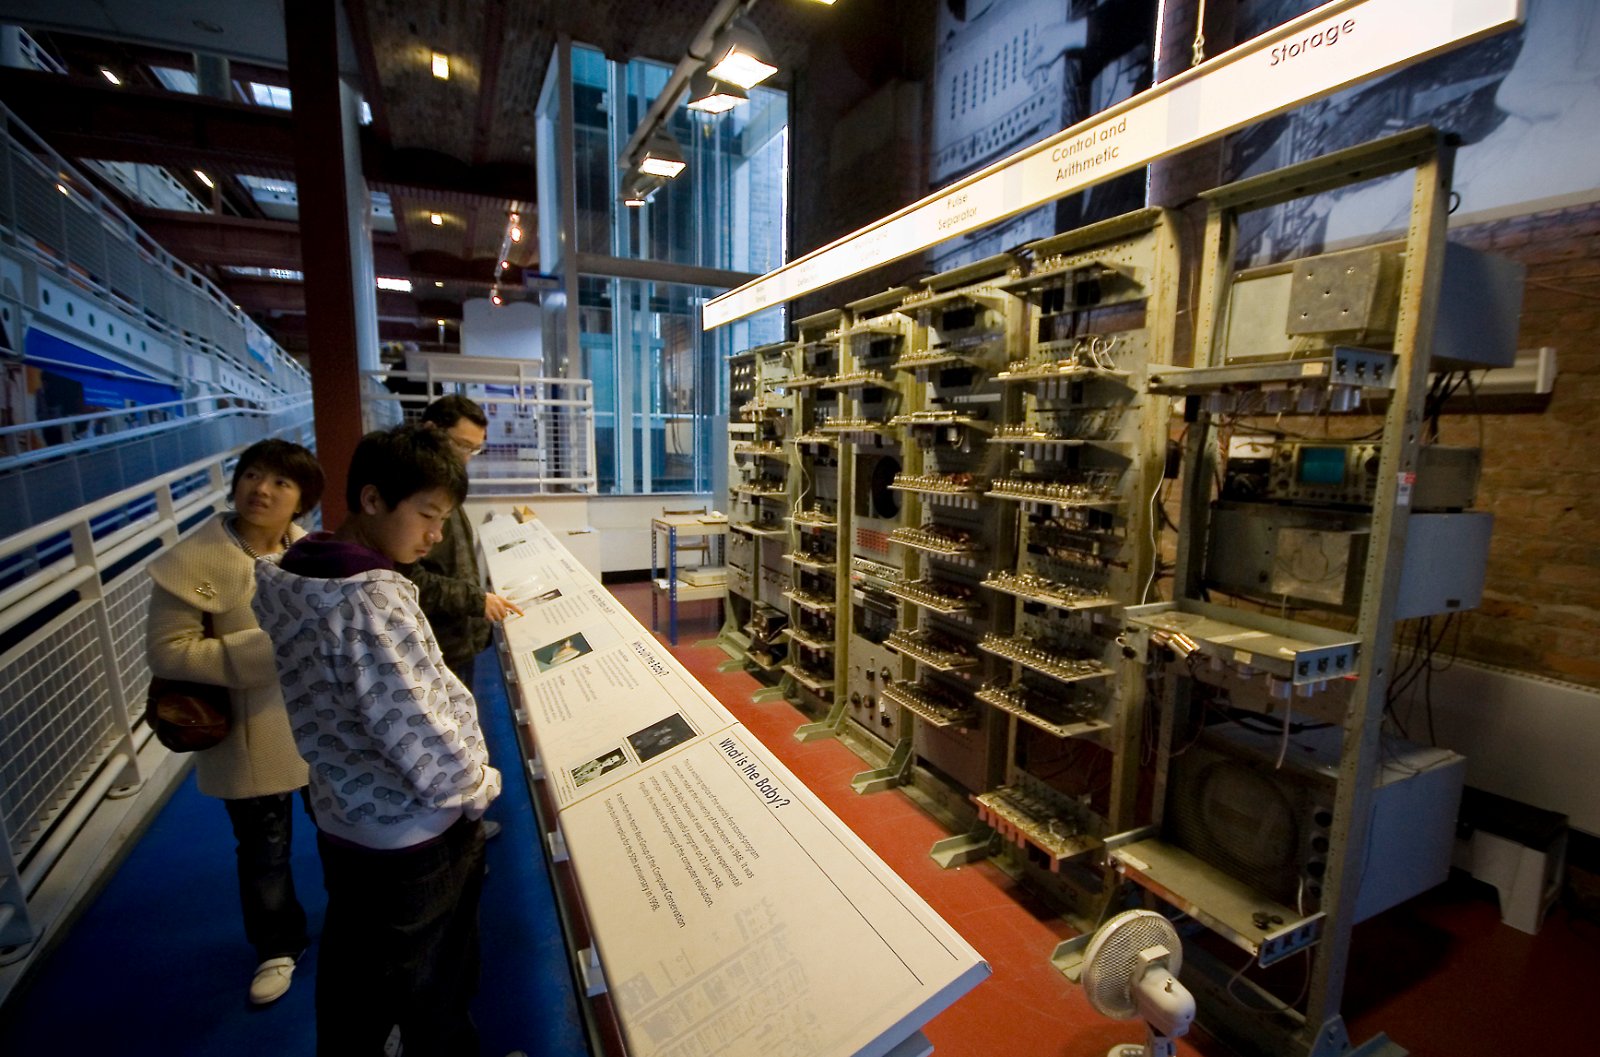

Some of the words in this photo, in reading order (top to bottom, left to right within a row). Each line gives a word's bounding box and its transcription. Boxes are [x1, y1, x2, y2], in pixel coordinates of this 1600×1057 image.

[1270, 19, 1355, 66] Storage
[1052, 132, 1096, 162] Control
[1100, 117, 1127, 141] and
[1056, 146, 1119, 182] Arithmetic
[938, 207, 977, 230] Separator
[717, 736, 744, 760] What
[734, 755, 751, 767] is
[741, 762, 764, 781] the
[690, 791, 700, 800] the
[710, 796, 721, 806] the
[755, 777, 790, 810] Baby?
[667, 804, 678, 815] first
[693, 797, 712, 818] University
[628, 818, 640, 832] North
[658, 815, 667, 824] the
[672, 812, 690, 834] successful
[724, 815, 737, 827] first
[621, 837, 631, 847] for
[634, 829, 645, 842] West
[660, 821, 679, 845] beginning
[681, 831, 699, 853] program
[710, 819, 732, 846] Manchester
[729, 823, 762, 861] stored-program
[624, 843, 634, 855] the
[637, 839, 651, 856] Group
[676, 846, 686, 857] the
[693, 820, 702, 831] was
[713, 853, 742, 890] experimental
[730, 848, 744, 863] 1948.
[647, 857, 658, 869] the
[678, 854, 699, 881] computer
[701, 860, 716, 876] June
[743, 867, 754, 879] was
[630, 861, 651, 893] anniversary
[649, 865, 669, 894] Computer
[709, 873, 725, 891] 1948.
[693, 876, 715, 908] revolution.
[663, 889, 687, 929] Conservation
